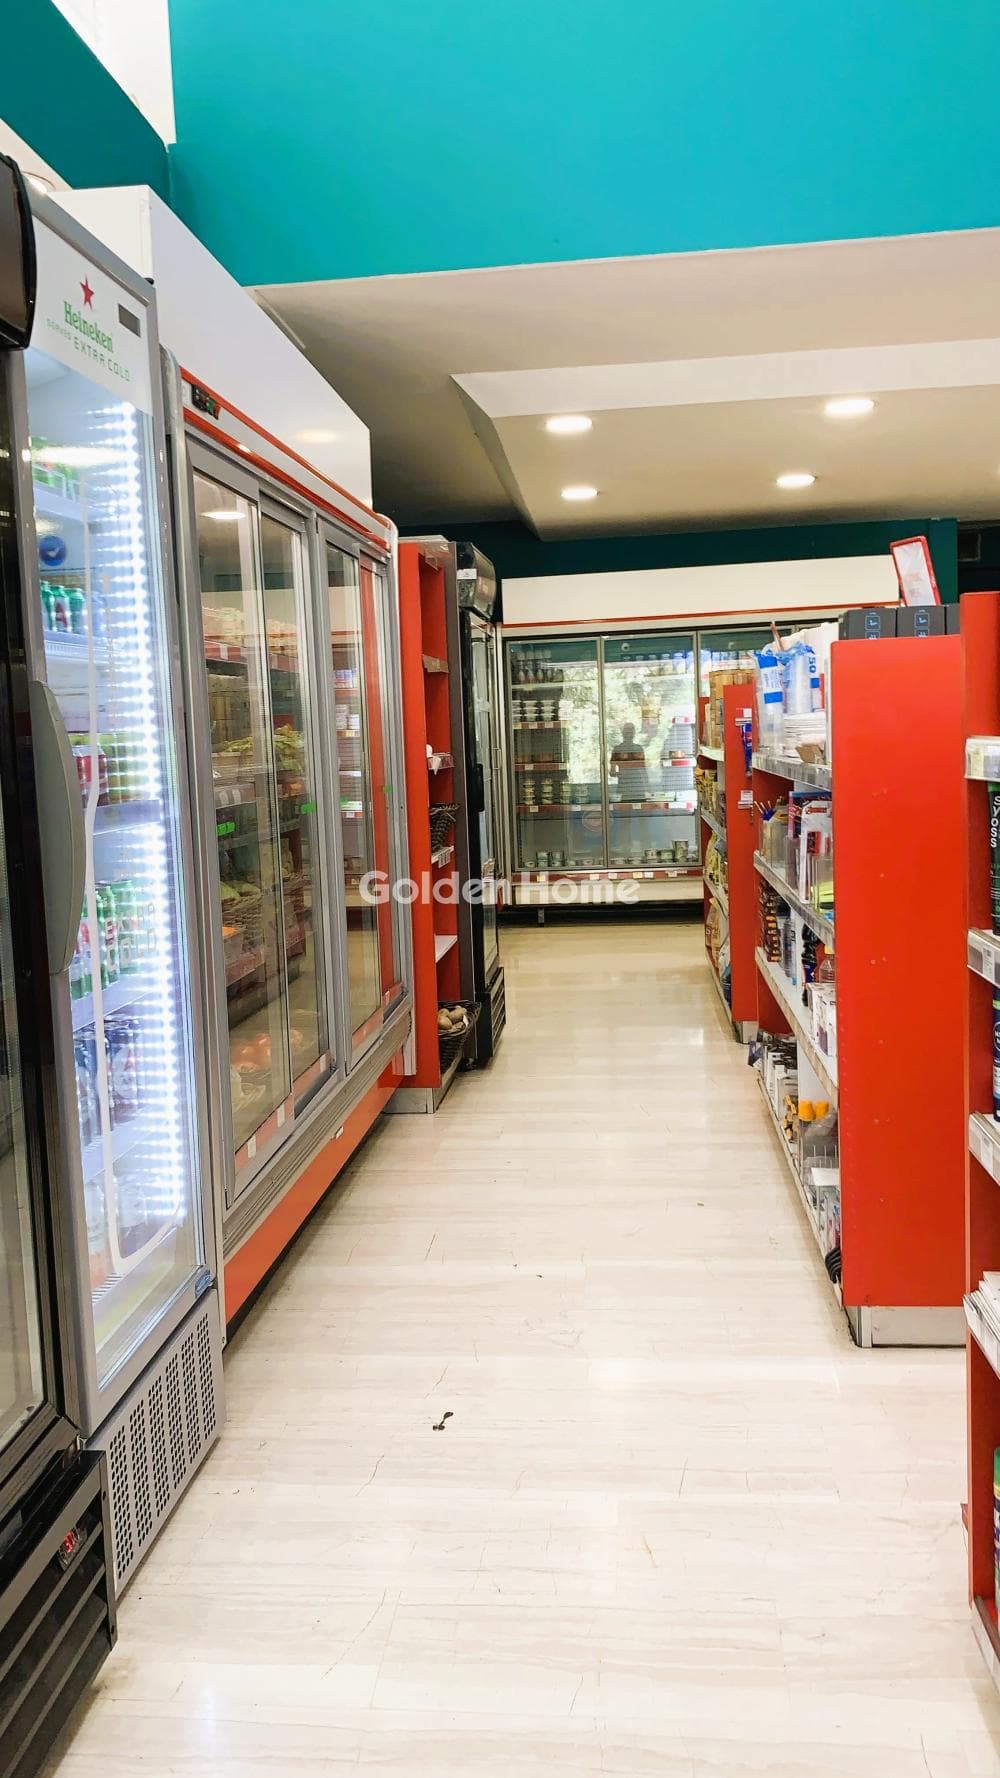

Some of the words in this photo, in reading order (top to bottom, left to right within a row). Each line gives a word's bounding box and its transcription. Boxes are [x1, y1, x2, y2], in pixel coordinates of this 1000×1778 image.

[63, 300, 113, 353] Heineken
[74, 336, 105, 367] EXTRA
[107, 358, 130, 382] COLD
